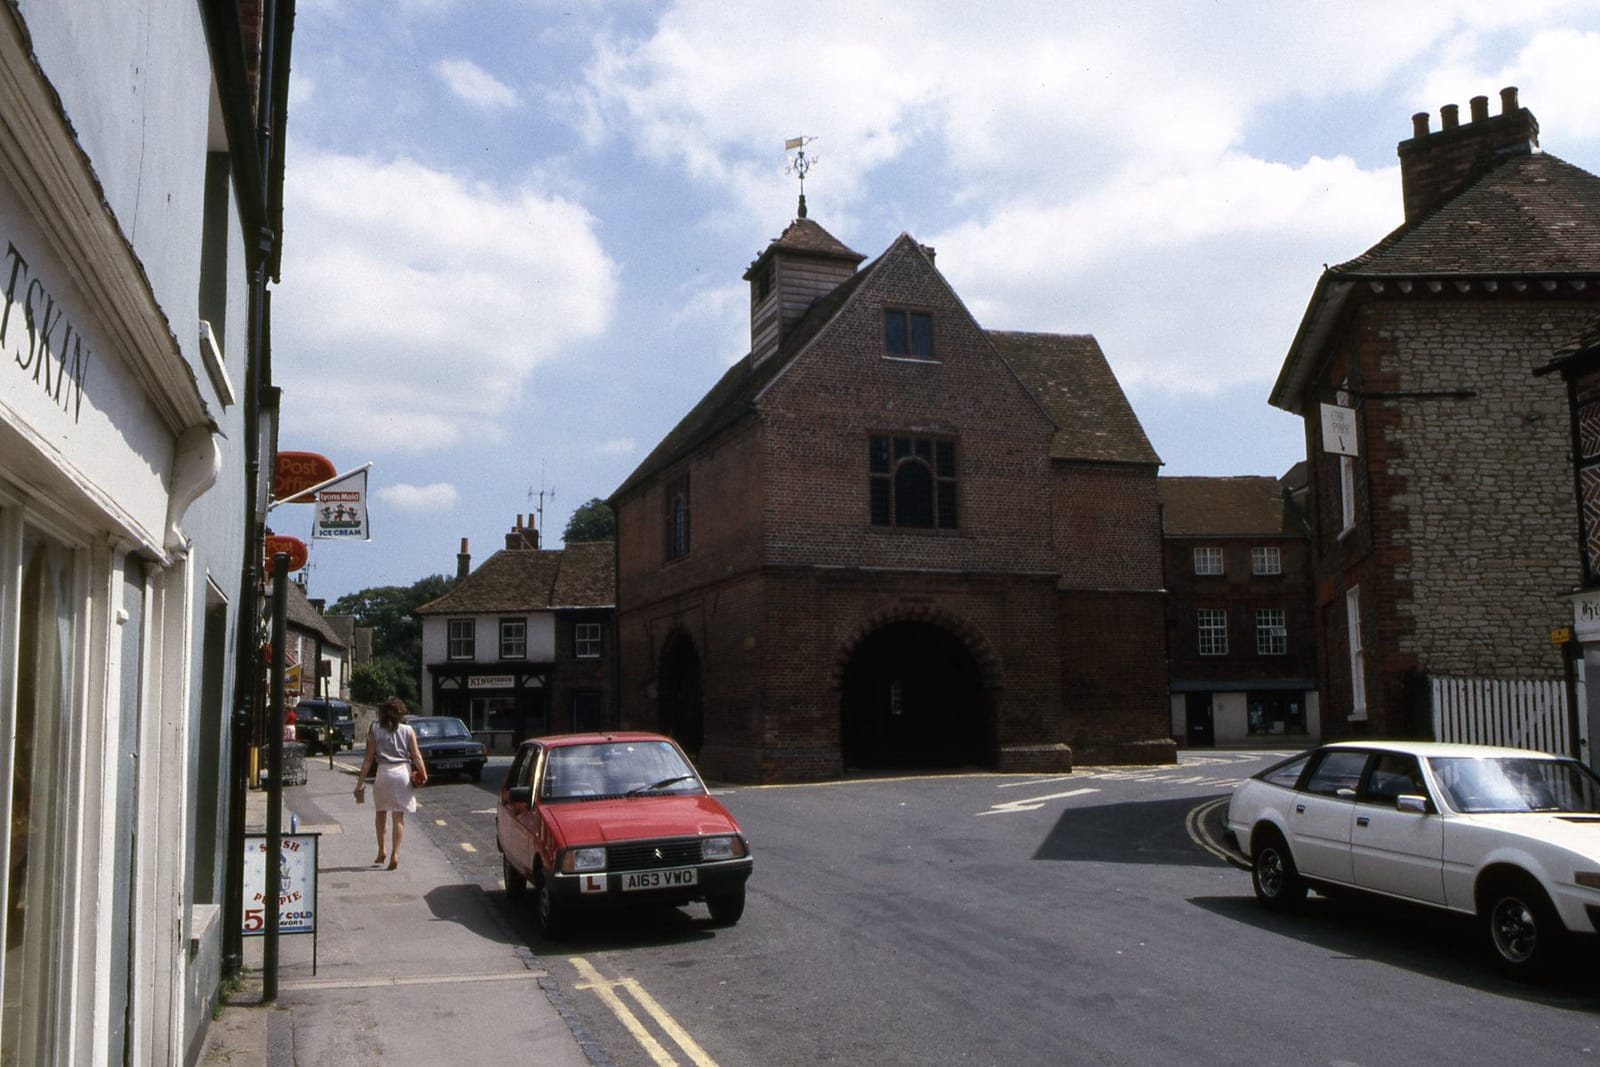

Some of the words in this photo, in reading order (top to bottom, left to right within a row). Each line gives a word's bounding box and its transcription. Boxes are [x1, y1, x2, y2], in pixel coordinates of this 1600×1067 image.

[281, 458, 318, 476] Post
[321, 493, 340, 502] Lyons
[259, 840, 301, 853] SSH
[587, 876, 602, 891] L
[628, 873, 660, 889] A163
[253, 891, 301, 906] PPIE
[244, 909, 264, 931] 5
[286, 911, 313, 920] COLD
